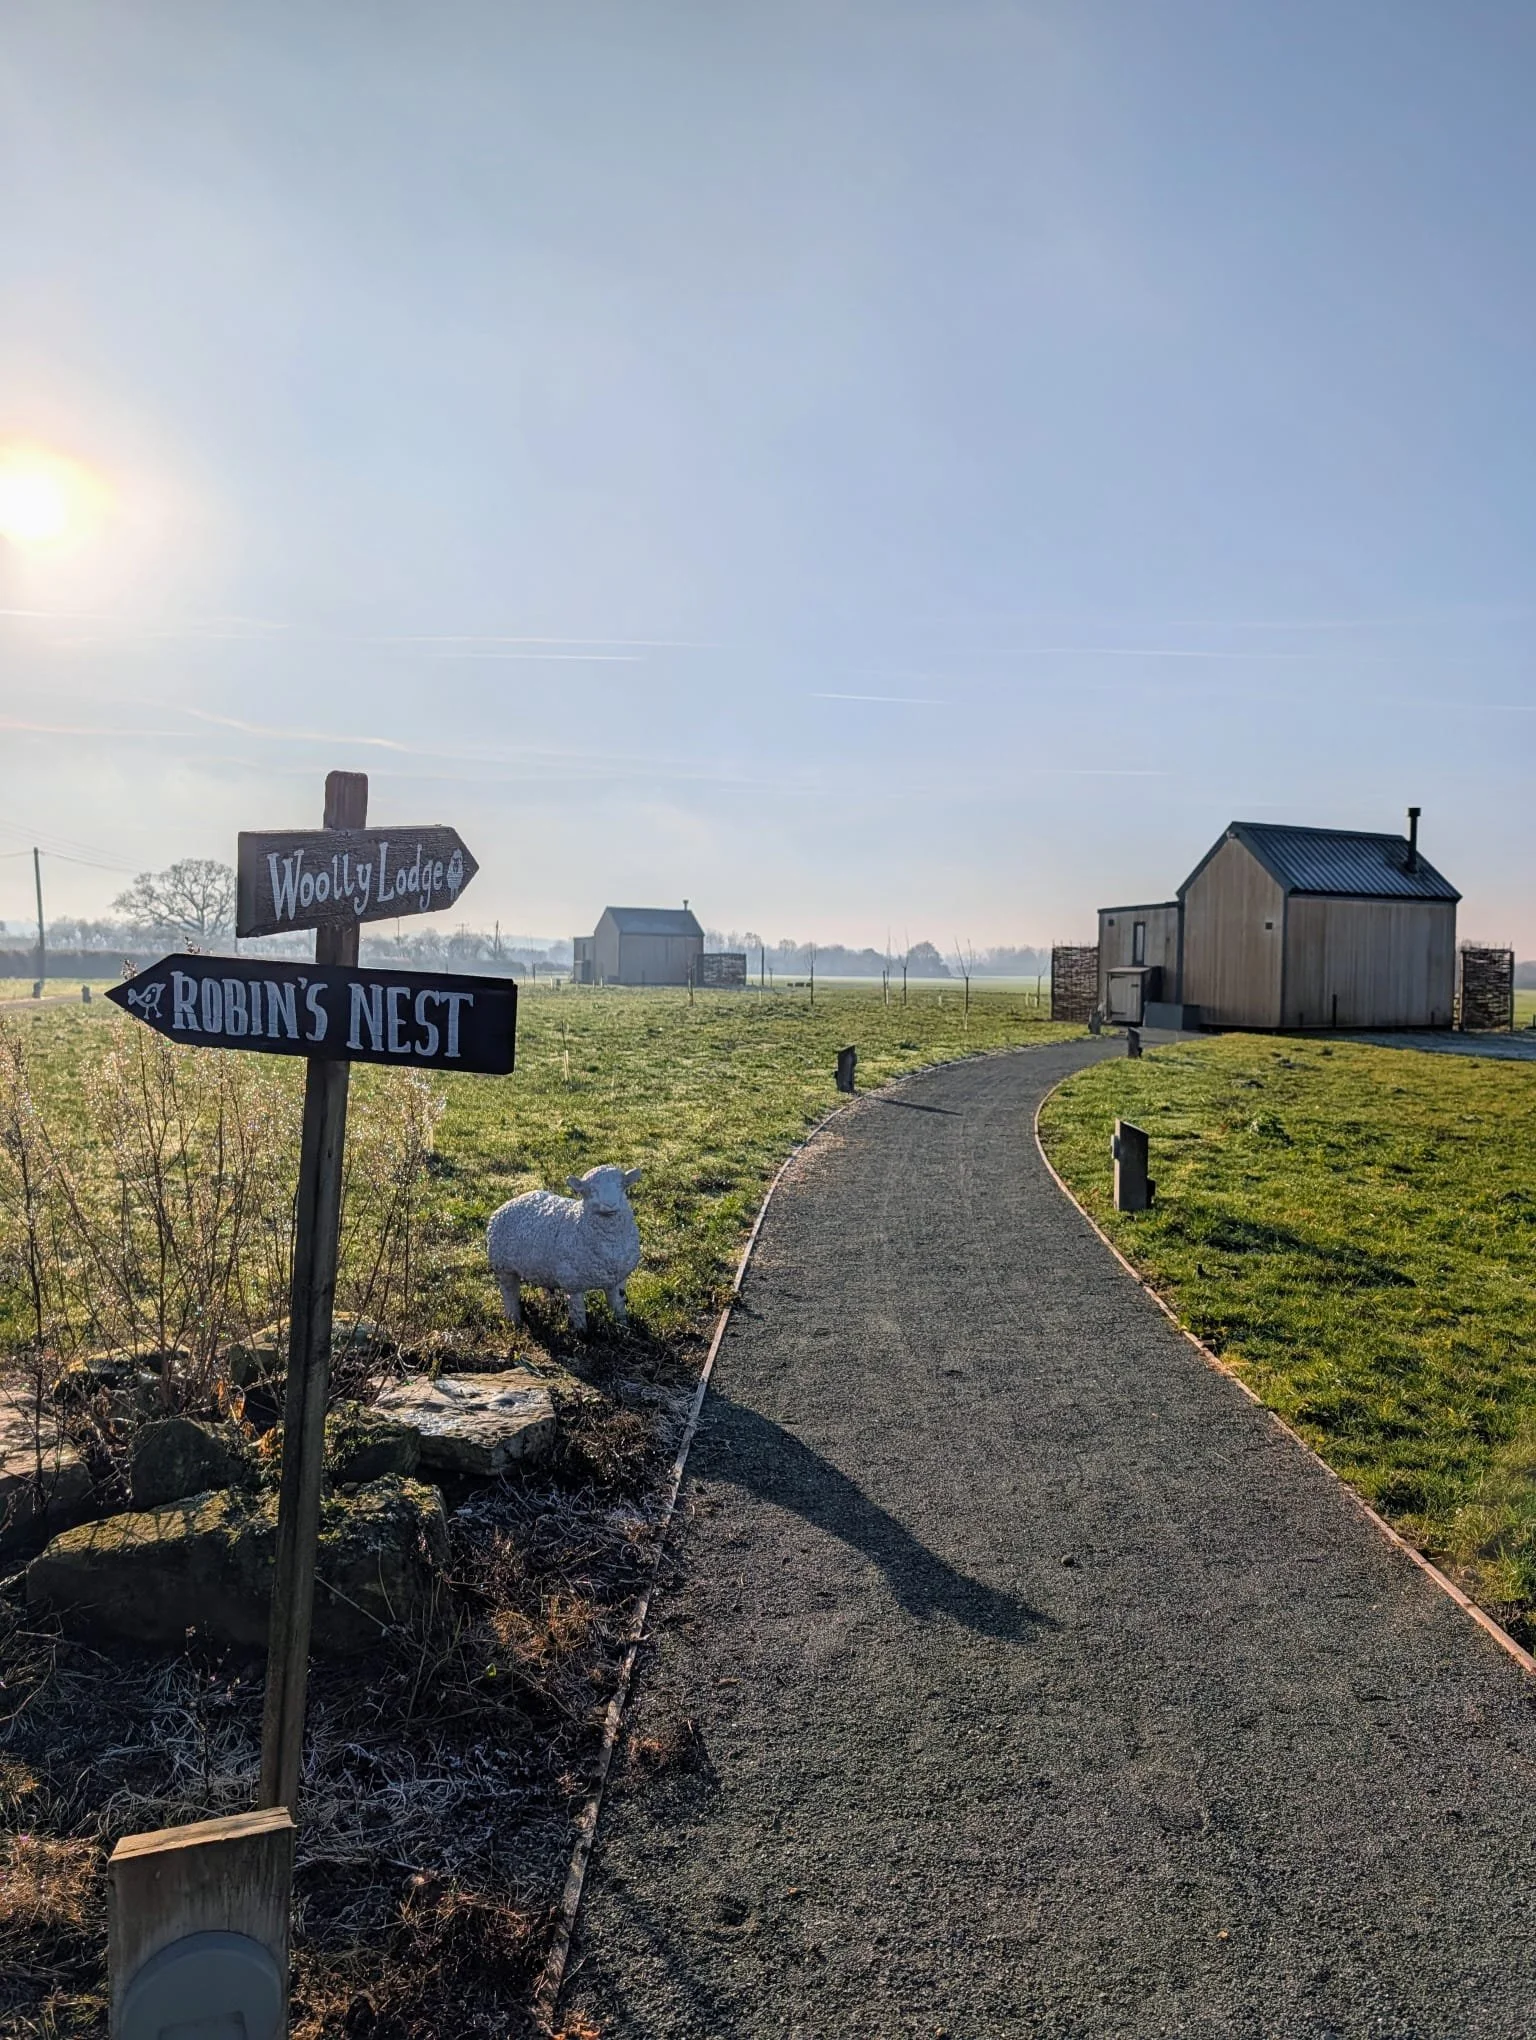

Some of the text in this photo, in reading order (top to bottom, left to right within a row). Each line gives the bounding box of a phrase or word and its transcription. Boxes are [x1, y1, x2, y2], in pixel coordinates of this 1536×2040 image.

[266, 841, 444, 921] Woolly Lodge
[170, 970, 474, 1058] ROBIN'S NEST
